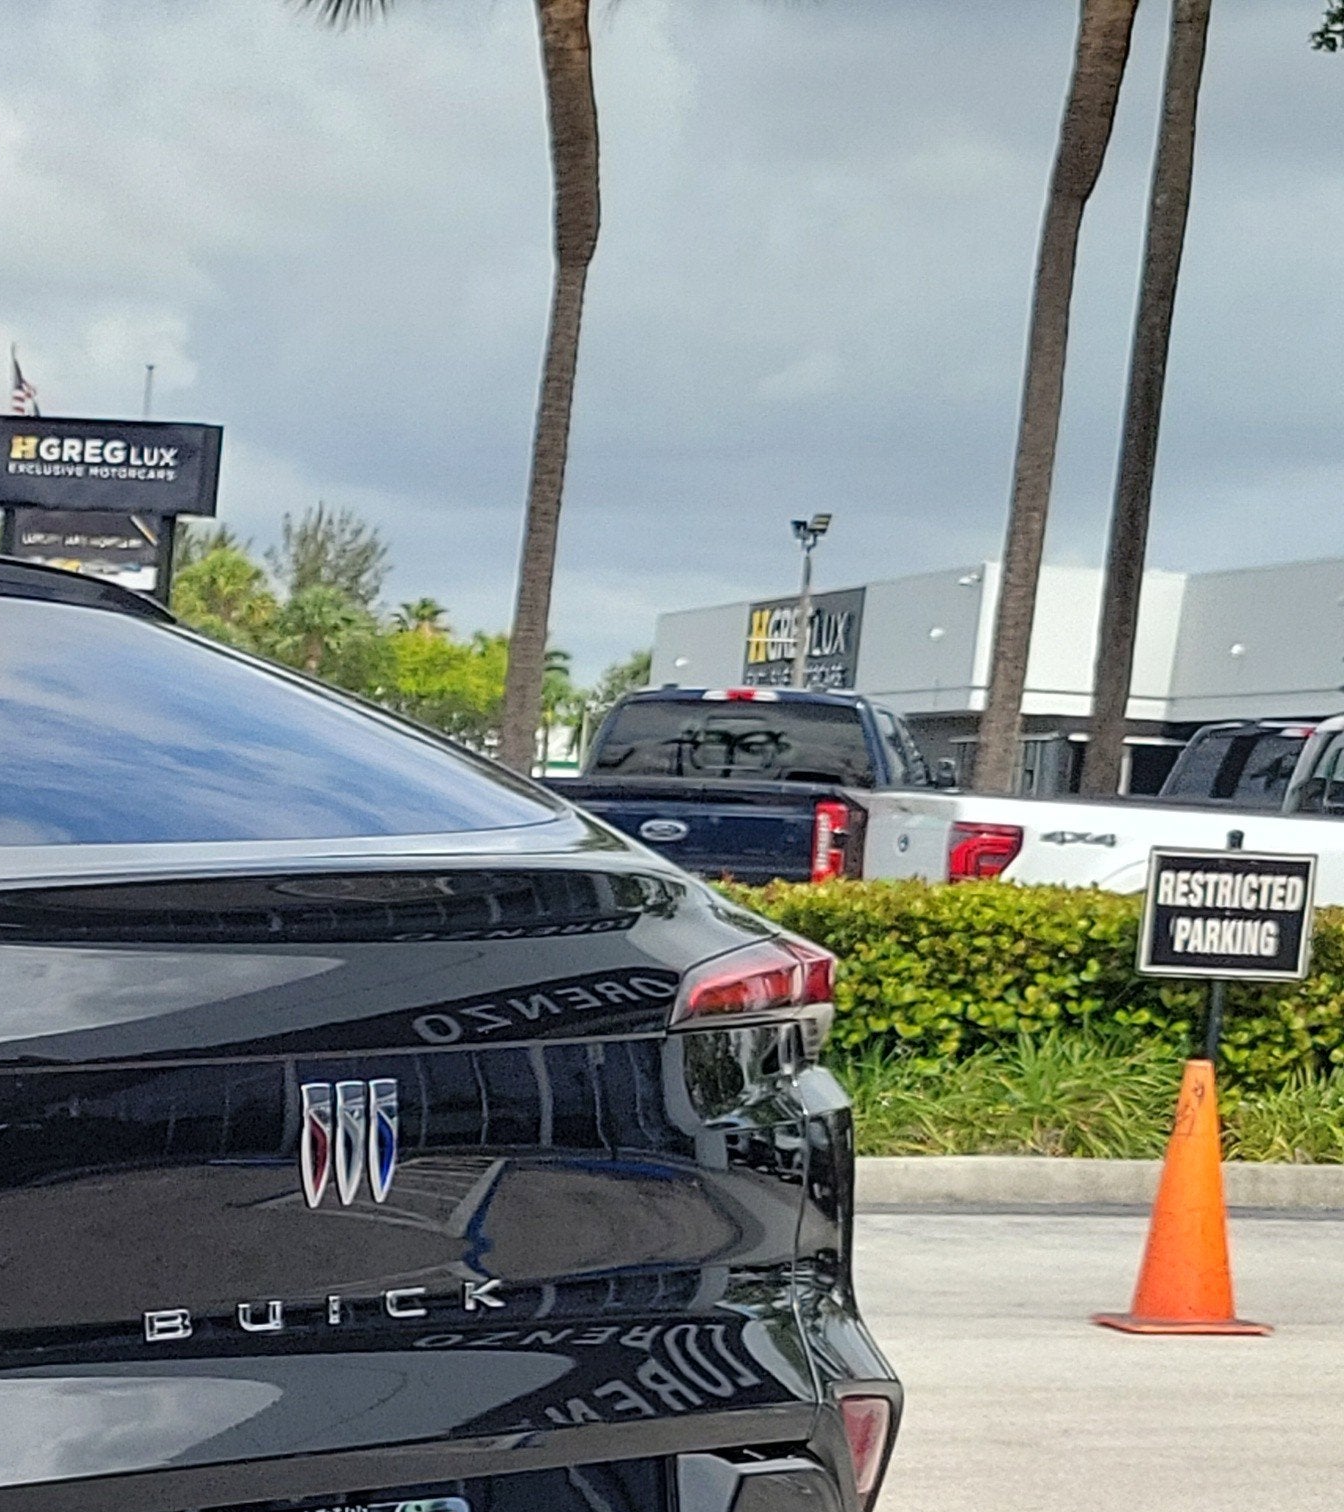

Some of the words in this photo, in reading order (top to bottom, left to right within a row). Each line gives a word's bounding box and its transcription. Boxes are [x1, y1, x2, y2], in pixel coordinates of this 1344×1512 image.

[1157, 870, 1305, 912] RESTRICTED
[1172, 916, 1280, 957] PARKING
[143, 1277, 507, 1342] BUICK
